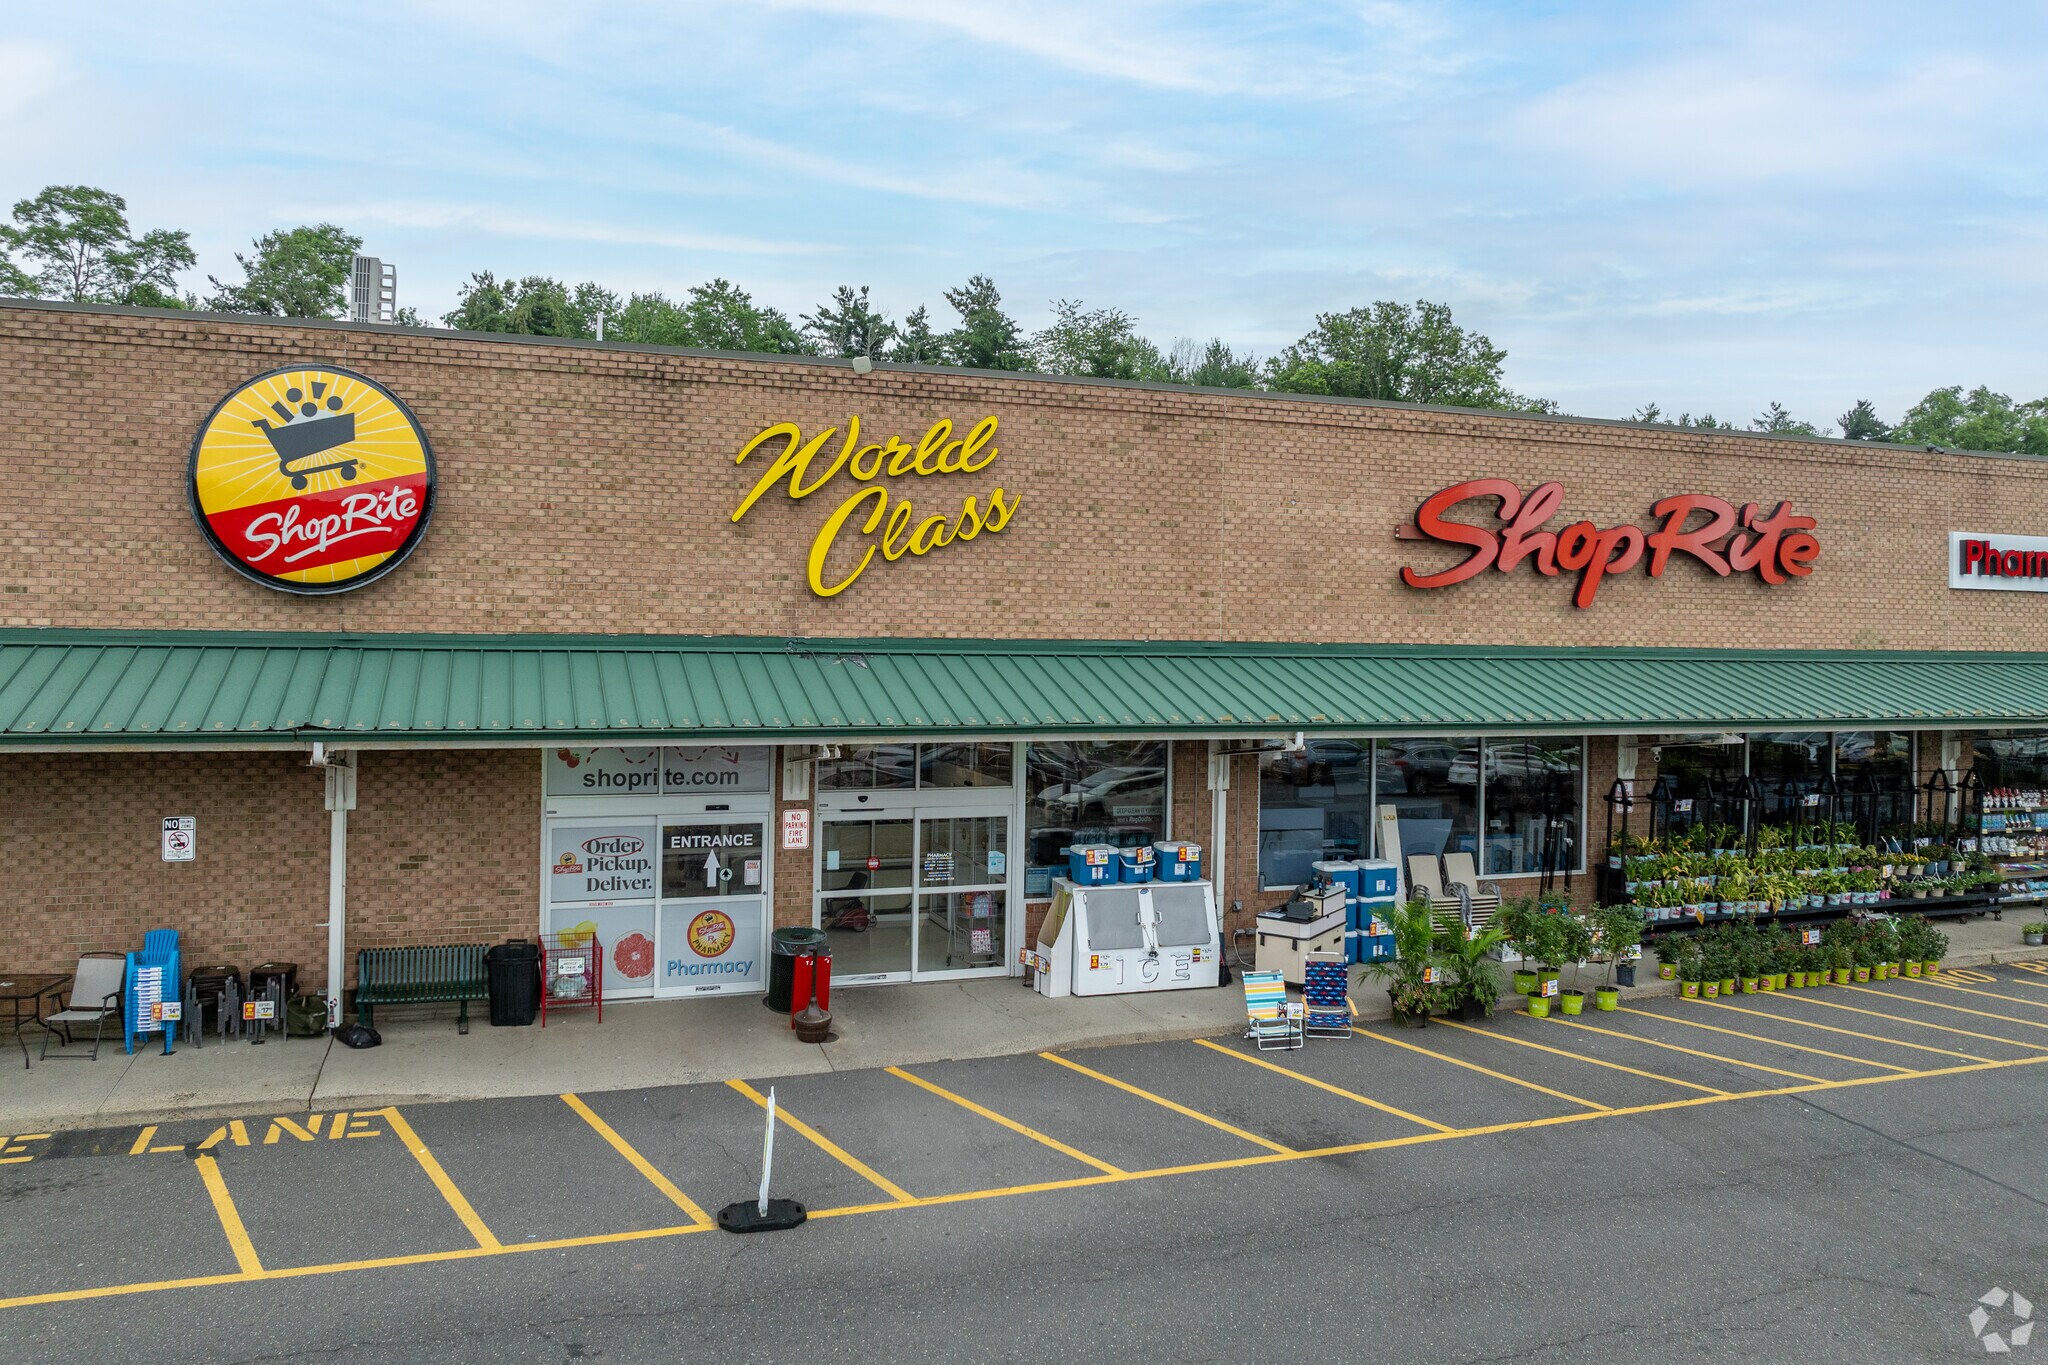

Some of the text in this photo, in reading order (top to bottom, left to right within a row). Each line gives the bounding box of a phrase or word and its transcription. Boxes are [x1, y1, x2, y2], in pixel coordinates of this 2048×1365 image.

[731, 415, 999, 522] World
[245, 485, 418, 562] ShopRite
[807, 486, 1022, 597] Class
[1400, 477, 1821, 608] ShopRite
[583, 768, 739, 791] shoprite.com
[165, 819, 179, 829] NO
[785, 821, 807, 829] PARKING
[791, 813, 801, 821] NO
[671, 833, 754, 849] ENTRANCE
[586, 855, 652, 874] Pickup.
[586, 876, 653, 892] Deliver.
[692, 932, 731, 954] PHARMACY
[667, 959, 754, 977] Pharmacy
[1115, 953, 1191, 985] ICE
[129, 1110, 386, 1155] LANE
